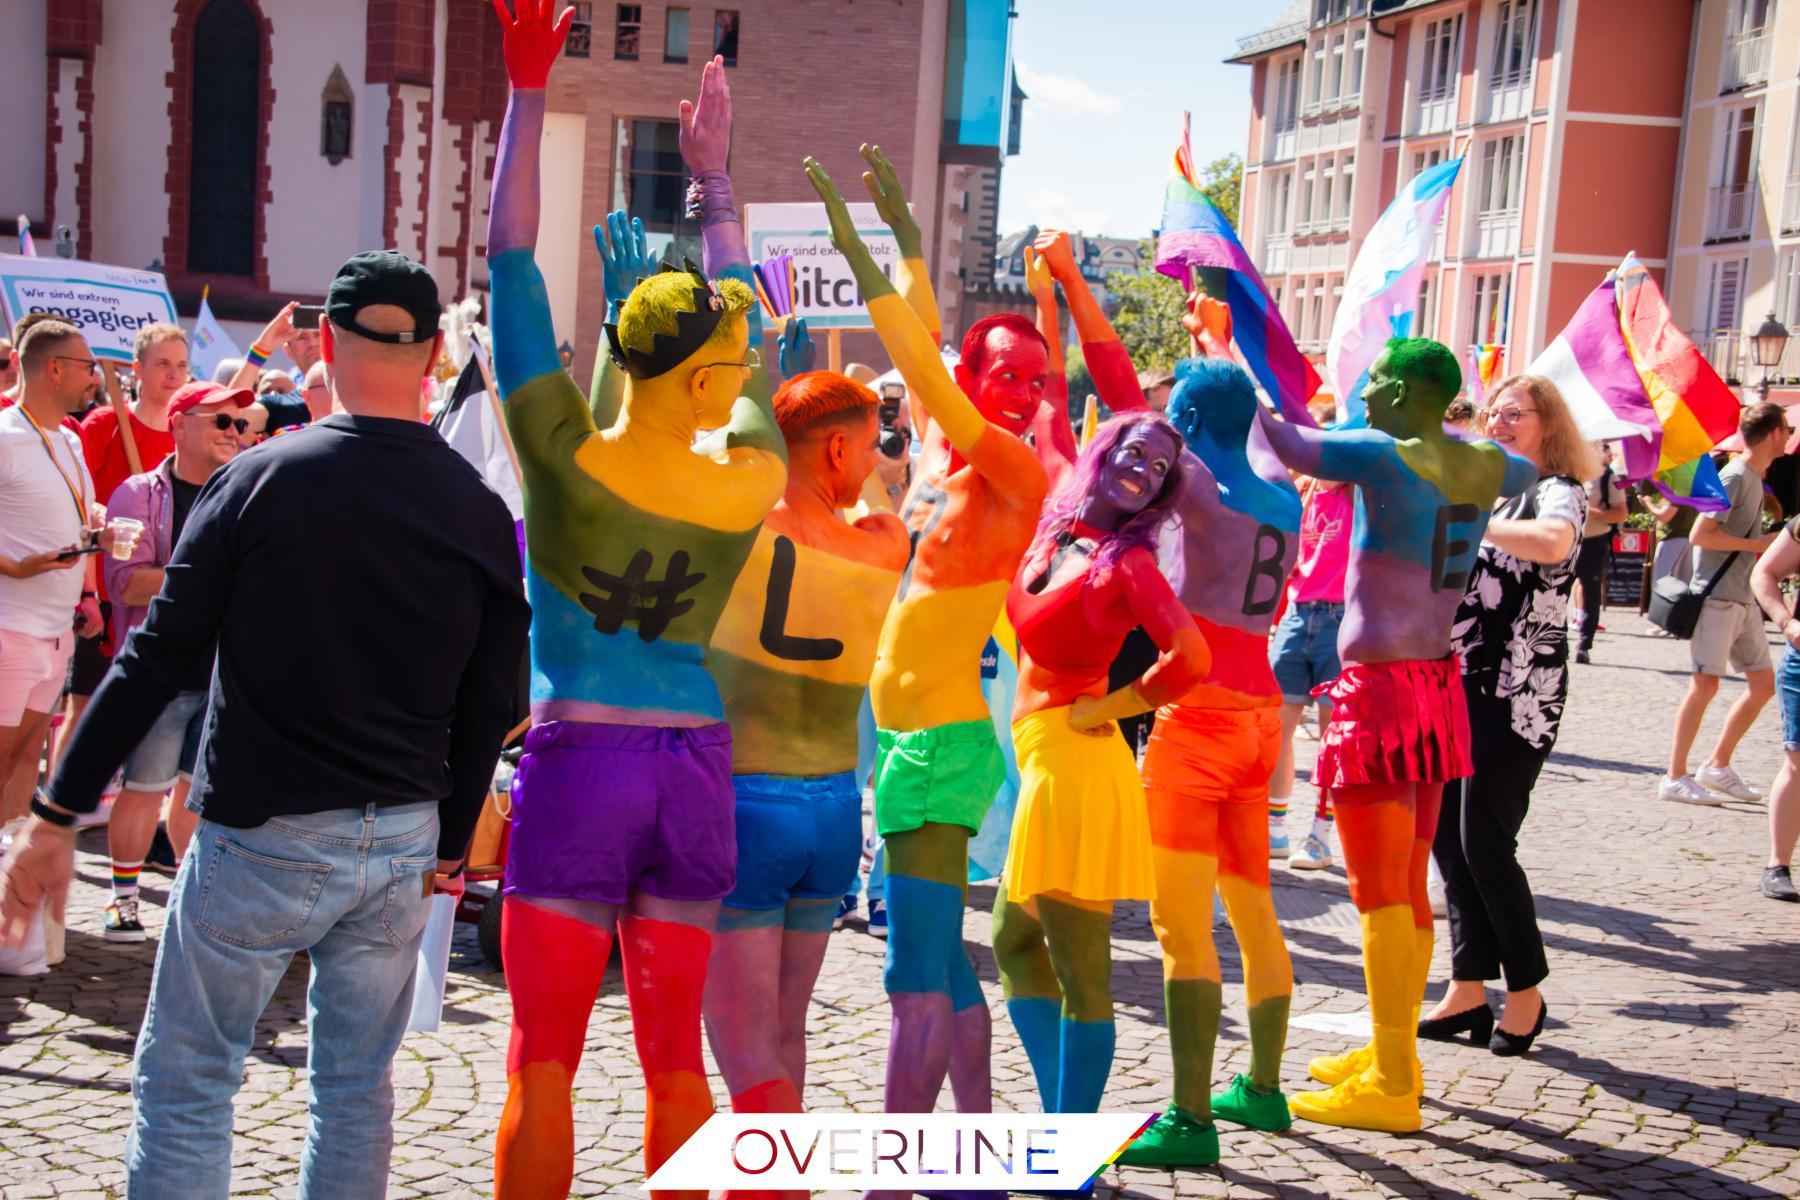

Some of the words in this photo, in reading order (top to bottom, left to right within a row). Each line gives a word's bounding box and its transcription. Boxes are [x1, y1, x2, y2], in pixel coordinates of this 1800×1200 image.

[767, 244, 790, 257] Wir
[793, 243, 817, 256] sind
[868, 243, 890, 256] tolz
[21, 287, 46, 299] Wir
[49, 289, 75, 301] sind
[78, 292, 121, 306] extrem
[1241, 523, 1286, 616] B
[1430, 503, 1479, 594] E
[579, 548, 706, 643] #
[759, 535, 844, 661] L
